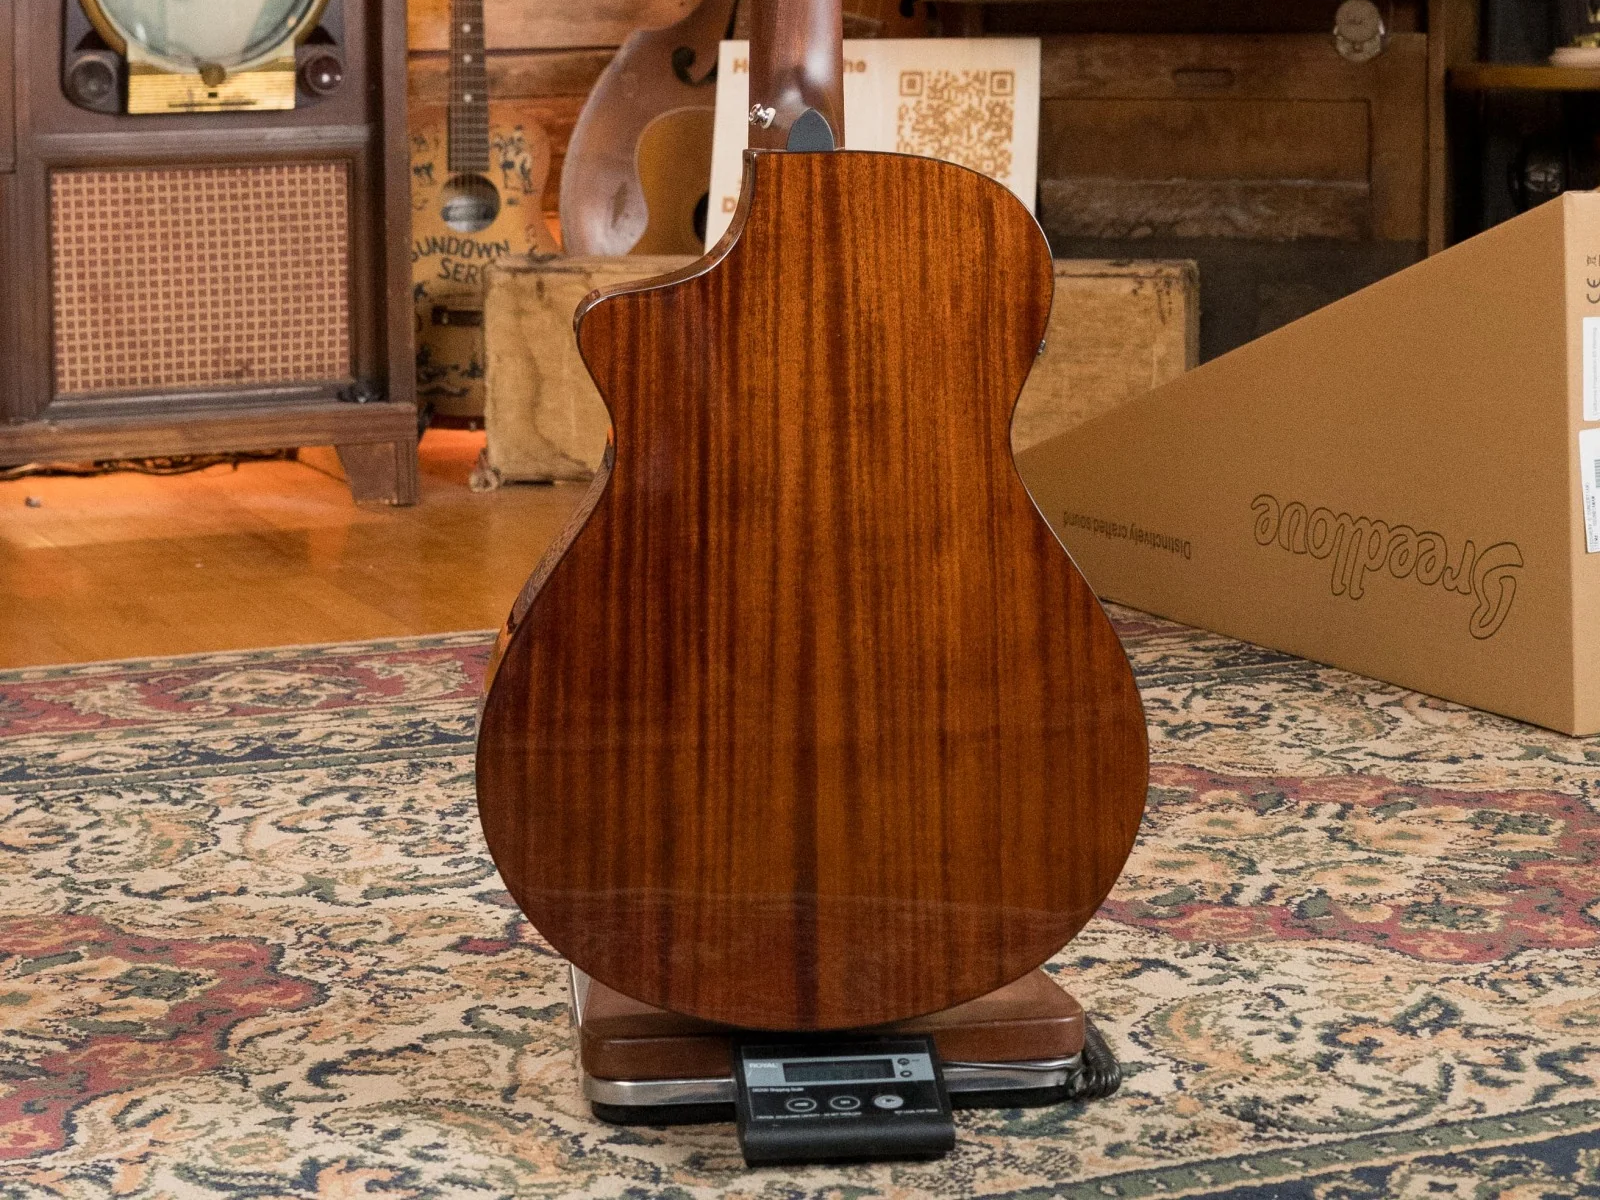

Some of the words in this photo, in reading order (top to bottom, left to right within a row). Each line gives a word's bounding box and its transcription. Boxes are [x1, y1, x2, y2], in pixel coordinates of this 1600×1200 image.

[1094, 518, 1128, 540] crafted
[1129, 523, 1191, 560] Distinctively
[1251, 494, 1524, 640] Breedlove
